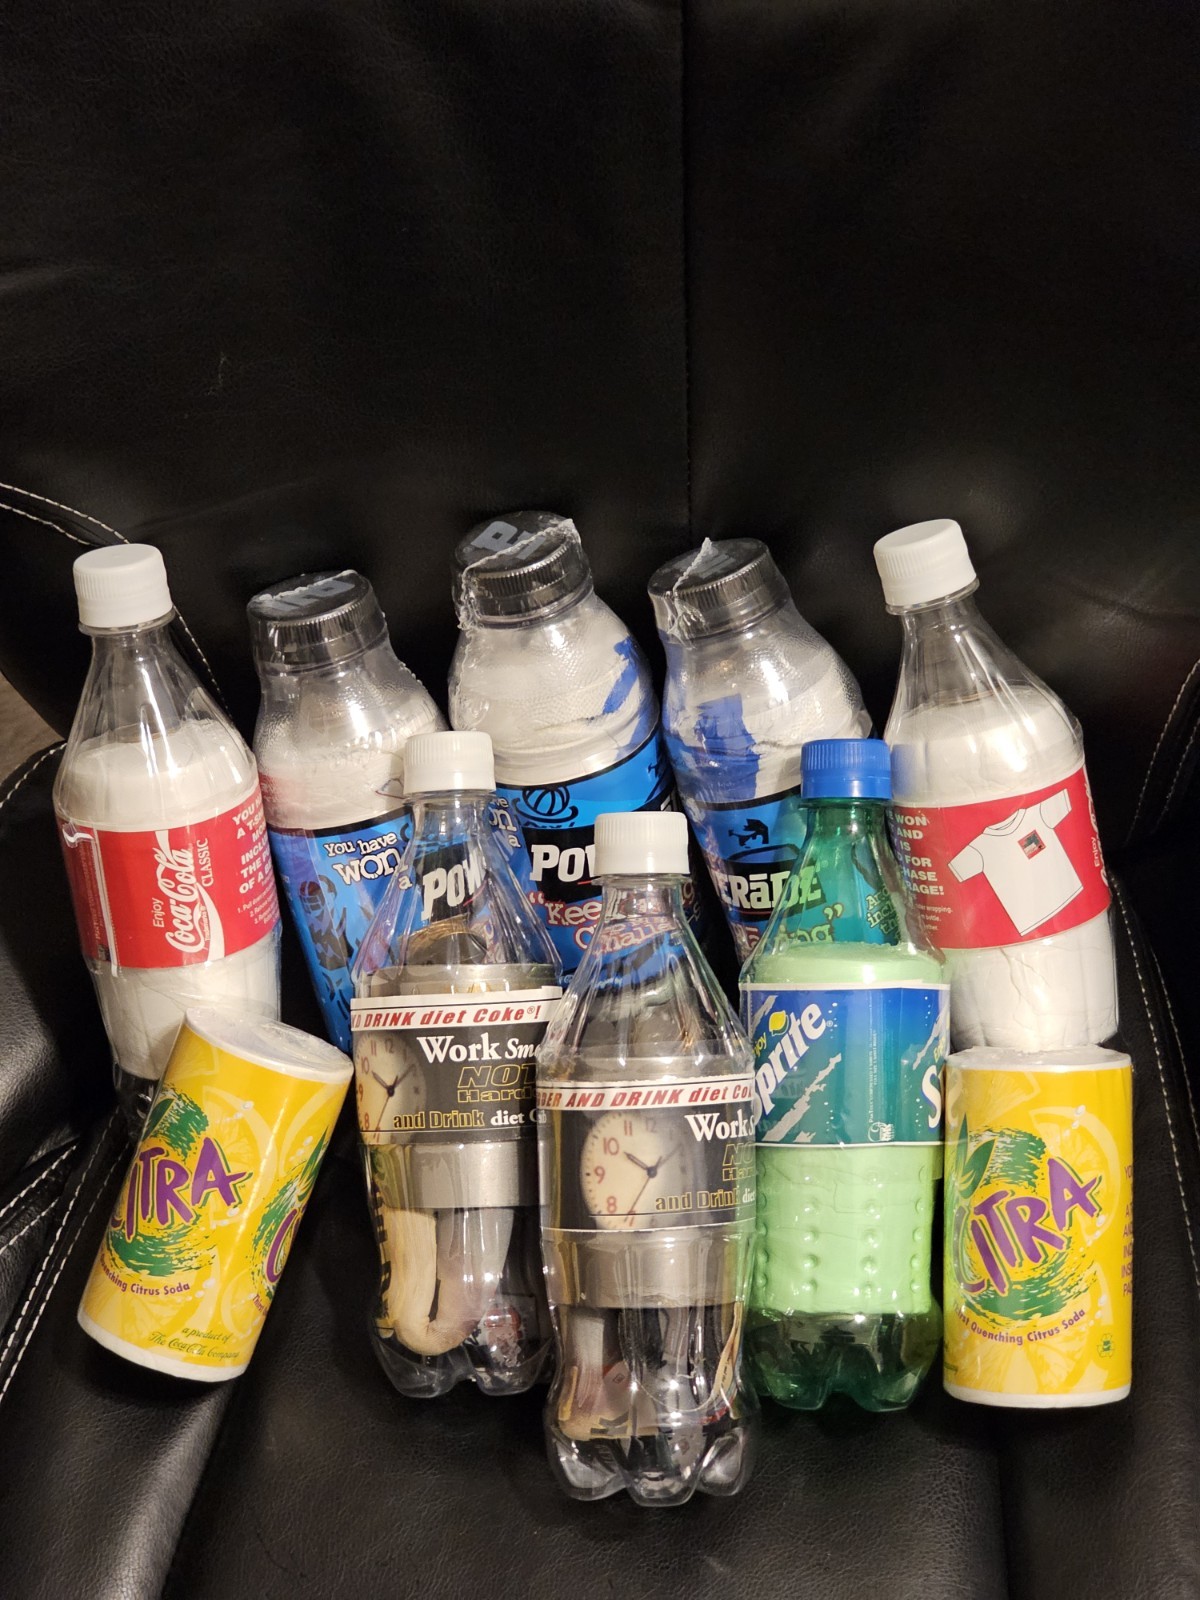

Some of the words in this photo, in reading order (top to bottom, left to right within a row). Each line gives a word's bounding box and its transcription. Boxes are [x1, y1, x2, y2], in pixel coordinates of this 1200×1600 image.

[232, 803, 255, 825] YOU
[895, 814, 928, 826] WON
[357, 832, 398, 855] have
[897, 827, 924, 840] AND
[196, 838, 214, 887] CLASSIC
[905, 855, 933, 868] FOR
[1091, 836, 1100, 868] Enjoy
[241, 857, 262, 878] THE
[239, 877, 255, 894] OF
[152, 847, 206, 953] Coca-Cola
[152, 898, 165, 928] Enjoy
[363, 1011, 416, 1028] DRINK
[420, 1009, 467, 1025] diet
[416, 1032, 502, 1064] Work
[565, 1092, 605, 1107] AND
[610, 1088, 684, 1107] DRINK
[688, 1086, 729, 1103] diet
[393, 1111, 426, 1129] and
[429, 1109, 485, 1129] Drink
[490, 1110, 525, 1126] diet
[684, 1109, 750, 1142] Work
[603, 1136, 620, 1156] 10
[594, 1165, 606, 1184] 9
[111, 1136, 248, 1241] ITRA
[606, 1195, 617, 1214] 8
[655, 1191, 692, 1211] and
[952, 1157, 1099, 1296] CITRA
[130, 1283, 160, 1296] Citrus
[163, 1282, 190, 1295] Soda
[970, 1321, 1024, 1346] Quenching
[1026, 1327, 1061, 1342] Citrus
[1061, 1308, 1086, 1331] Soda
